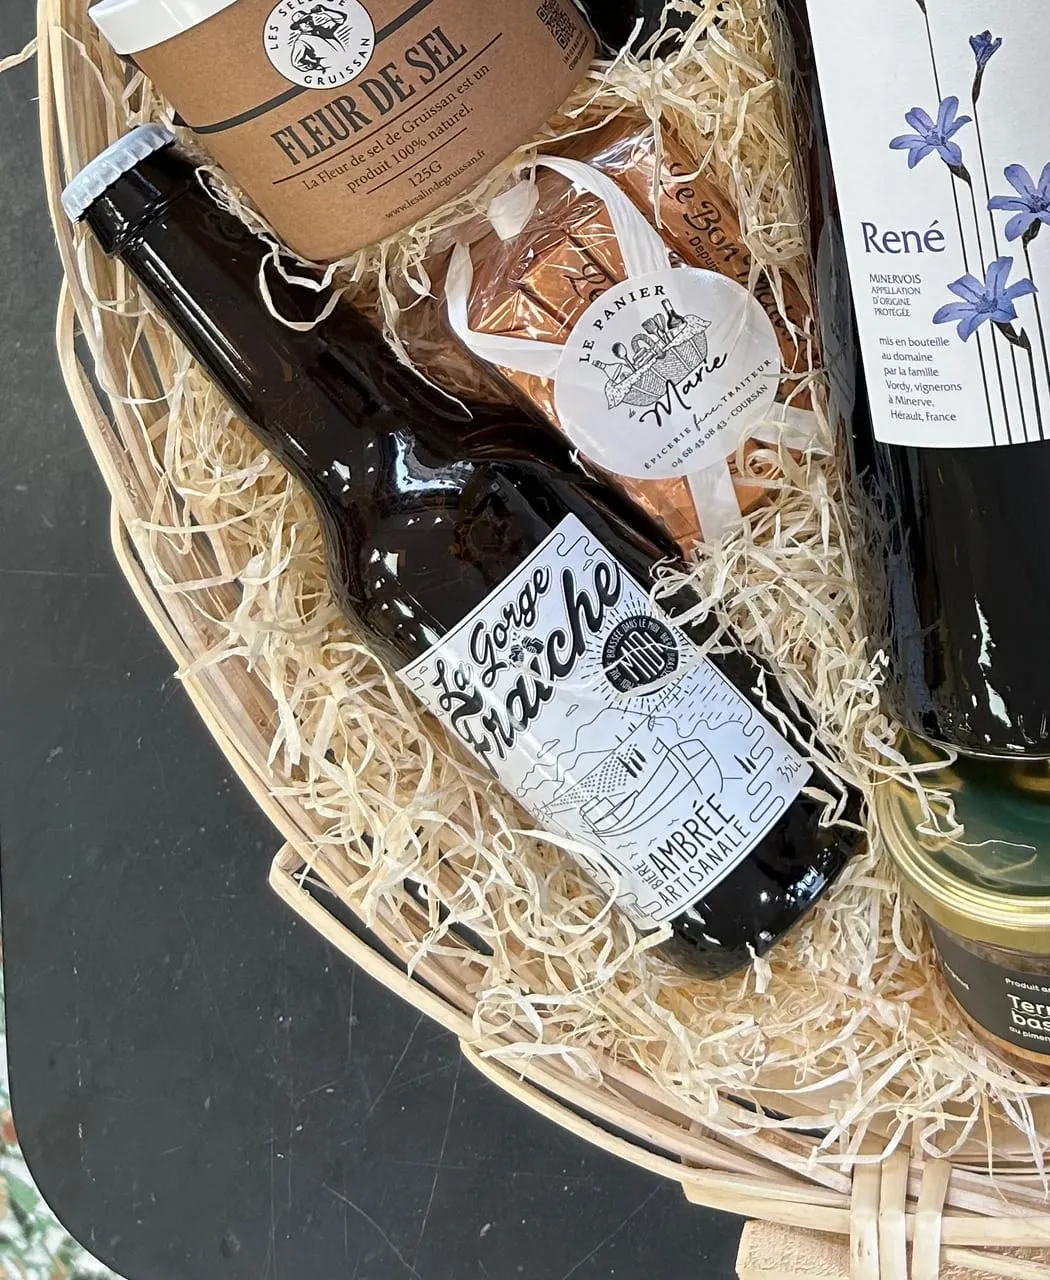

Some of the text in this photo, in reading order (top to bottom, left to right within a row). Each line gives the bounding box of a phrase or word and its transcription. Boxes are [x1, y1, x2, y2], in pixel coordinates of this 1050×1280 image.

[268, 25, 279, 50] LES
[304, 38, 371, 85] GRUISSAN
[270, 26, 468, 166] FLEUR DE SEL
[302, 64, 491, 191] La Fleur de sel de Gruissan est un
[346, 101, 475, 194] produit 100% naturel.
[385, 147, 487, 220] www.lesalindegruissan.fr
[408, 159, 444, 188] 125G
[860, 219, 946, 254] René
[869, 273, 922, 284] MINERVOIS
[871, 286, 921, 295] APPELLATION
[872, 296, 911, 306] D'ORIGINE
[874, 307, 911, 317] PROTÉGÉE
[579, 339, 595, 363] LE
[593, 285, 666, 331] PANIER
[879, 336, 950, 347] mis bouteille
[893, 352, 934, 362] domaine
[884, 366, 939, 377] par famille
[885, 379, 963, 394] Vordy, vignerons
[639, 352, 728, 428] Marie
[895, 395, 935, 408] Minerve,
[644, 358, 772, 470] ÉPICERIE TRAITEUR
[671, 384, 769, 469] 04 COURSAN
[890, 409, 957, 422] Hérault, France
[432, 567, 551, 713] La Gorge
[632, 792, 736, 891] BIÈRE AMBRÉE
[658, 819, 751, 908] ARTISANALE
[1005, 978, 1041, 992] Produit
